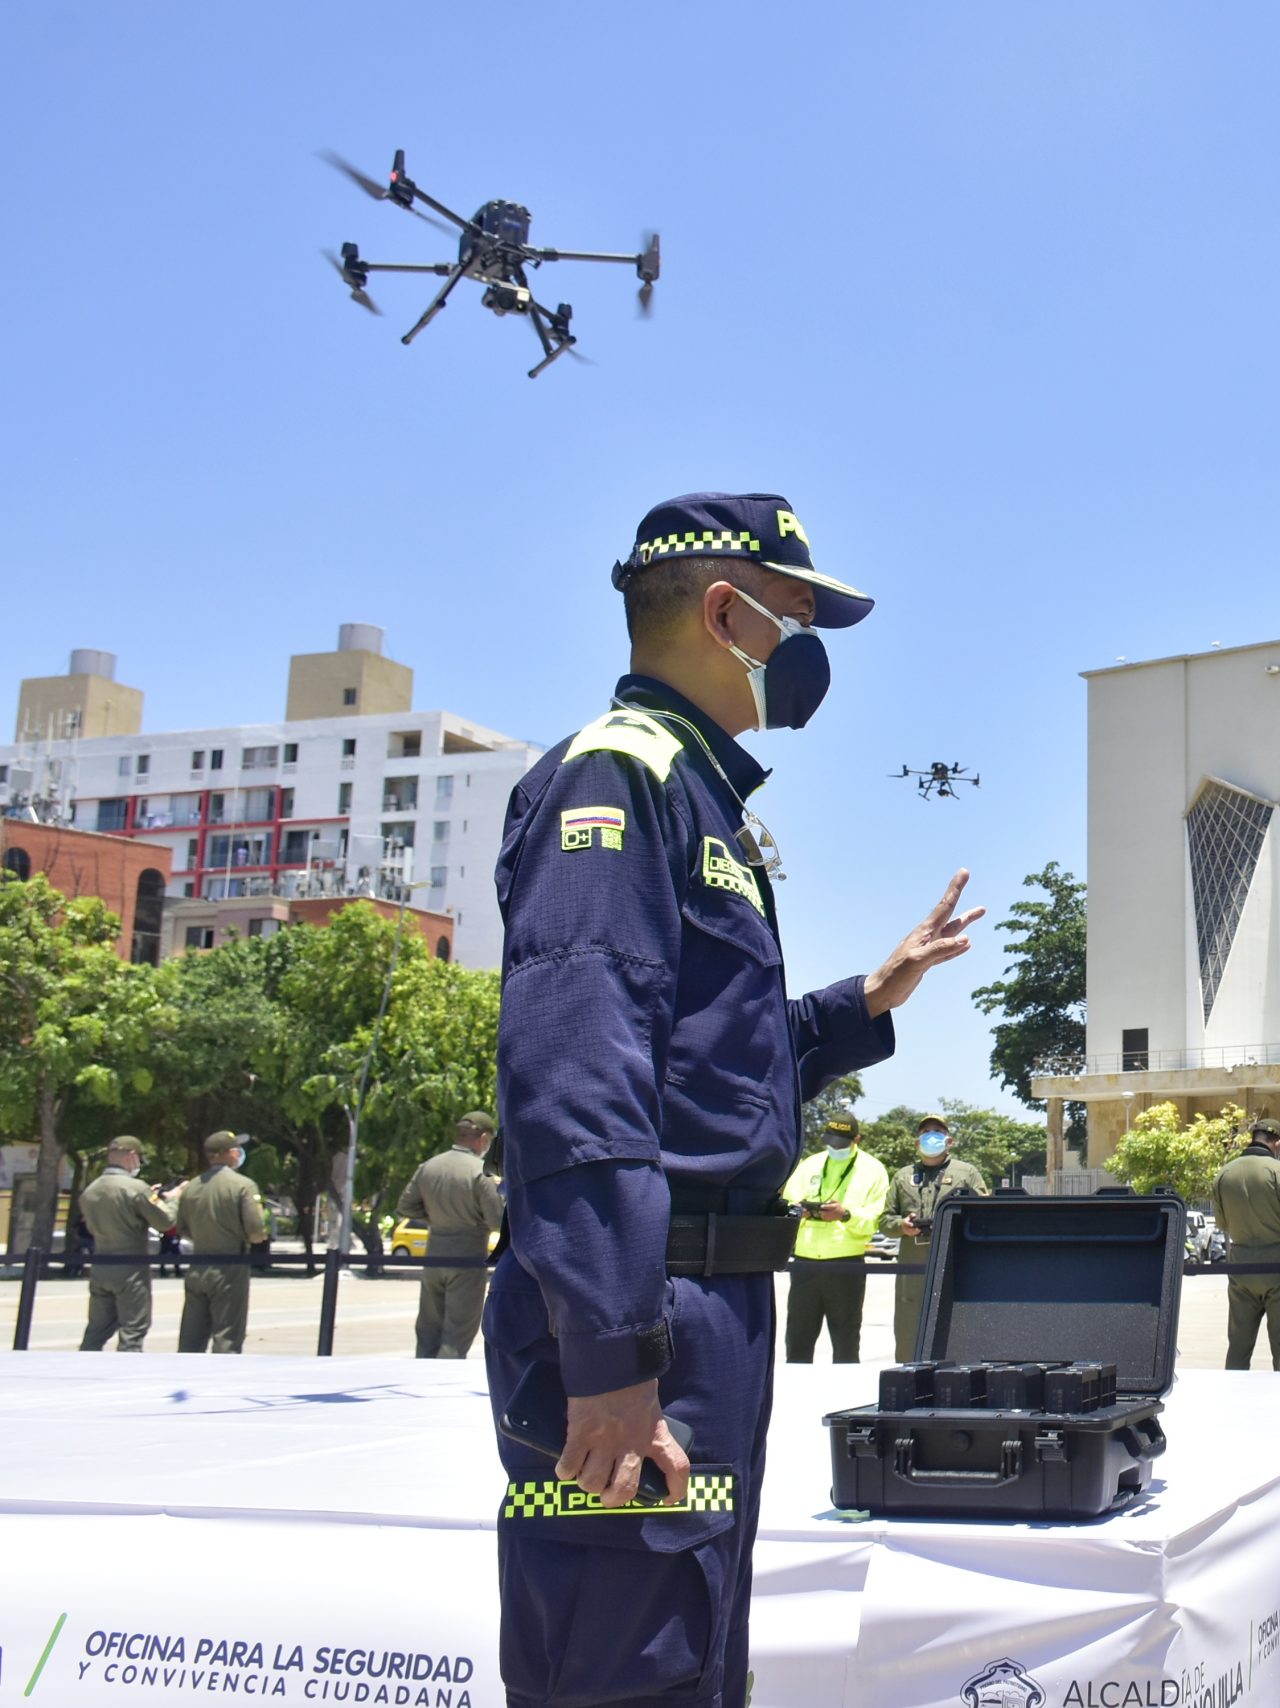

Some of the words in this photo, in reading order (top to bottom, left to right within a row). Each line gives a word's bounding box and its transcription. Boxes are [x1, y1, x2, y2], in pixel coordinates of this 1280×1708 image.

[1258, 1610, 1279, 1645] OFICINA
[85, 1630, 185, 1663] OFICINA
[194, 1638, 263, 1669] PARA
[273, 1644, 304, 1672] LA
[312, 1646, 474, 1683] SEGURIDAD
[78, 1661, 91, 1680] Y
[104, 1663, 286, 1696] CONVIVENCIA
[304, 1679, 472, 1708] CIUDADANA
[1062, 1668, 1193, 1708] ALCALDÍA
[1194, 1661, 1205, 1695] DE
